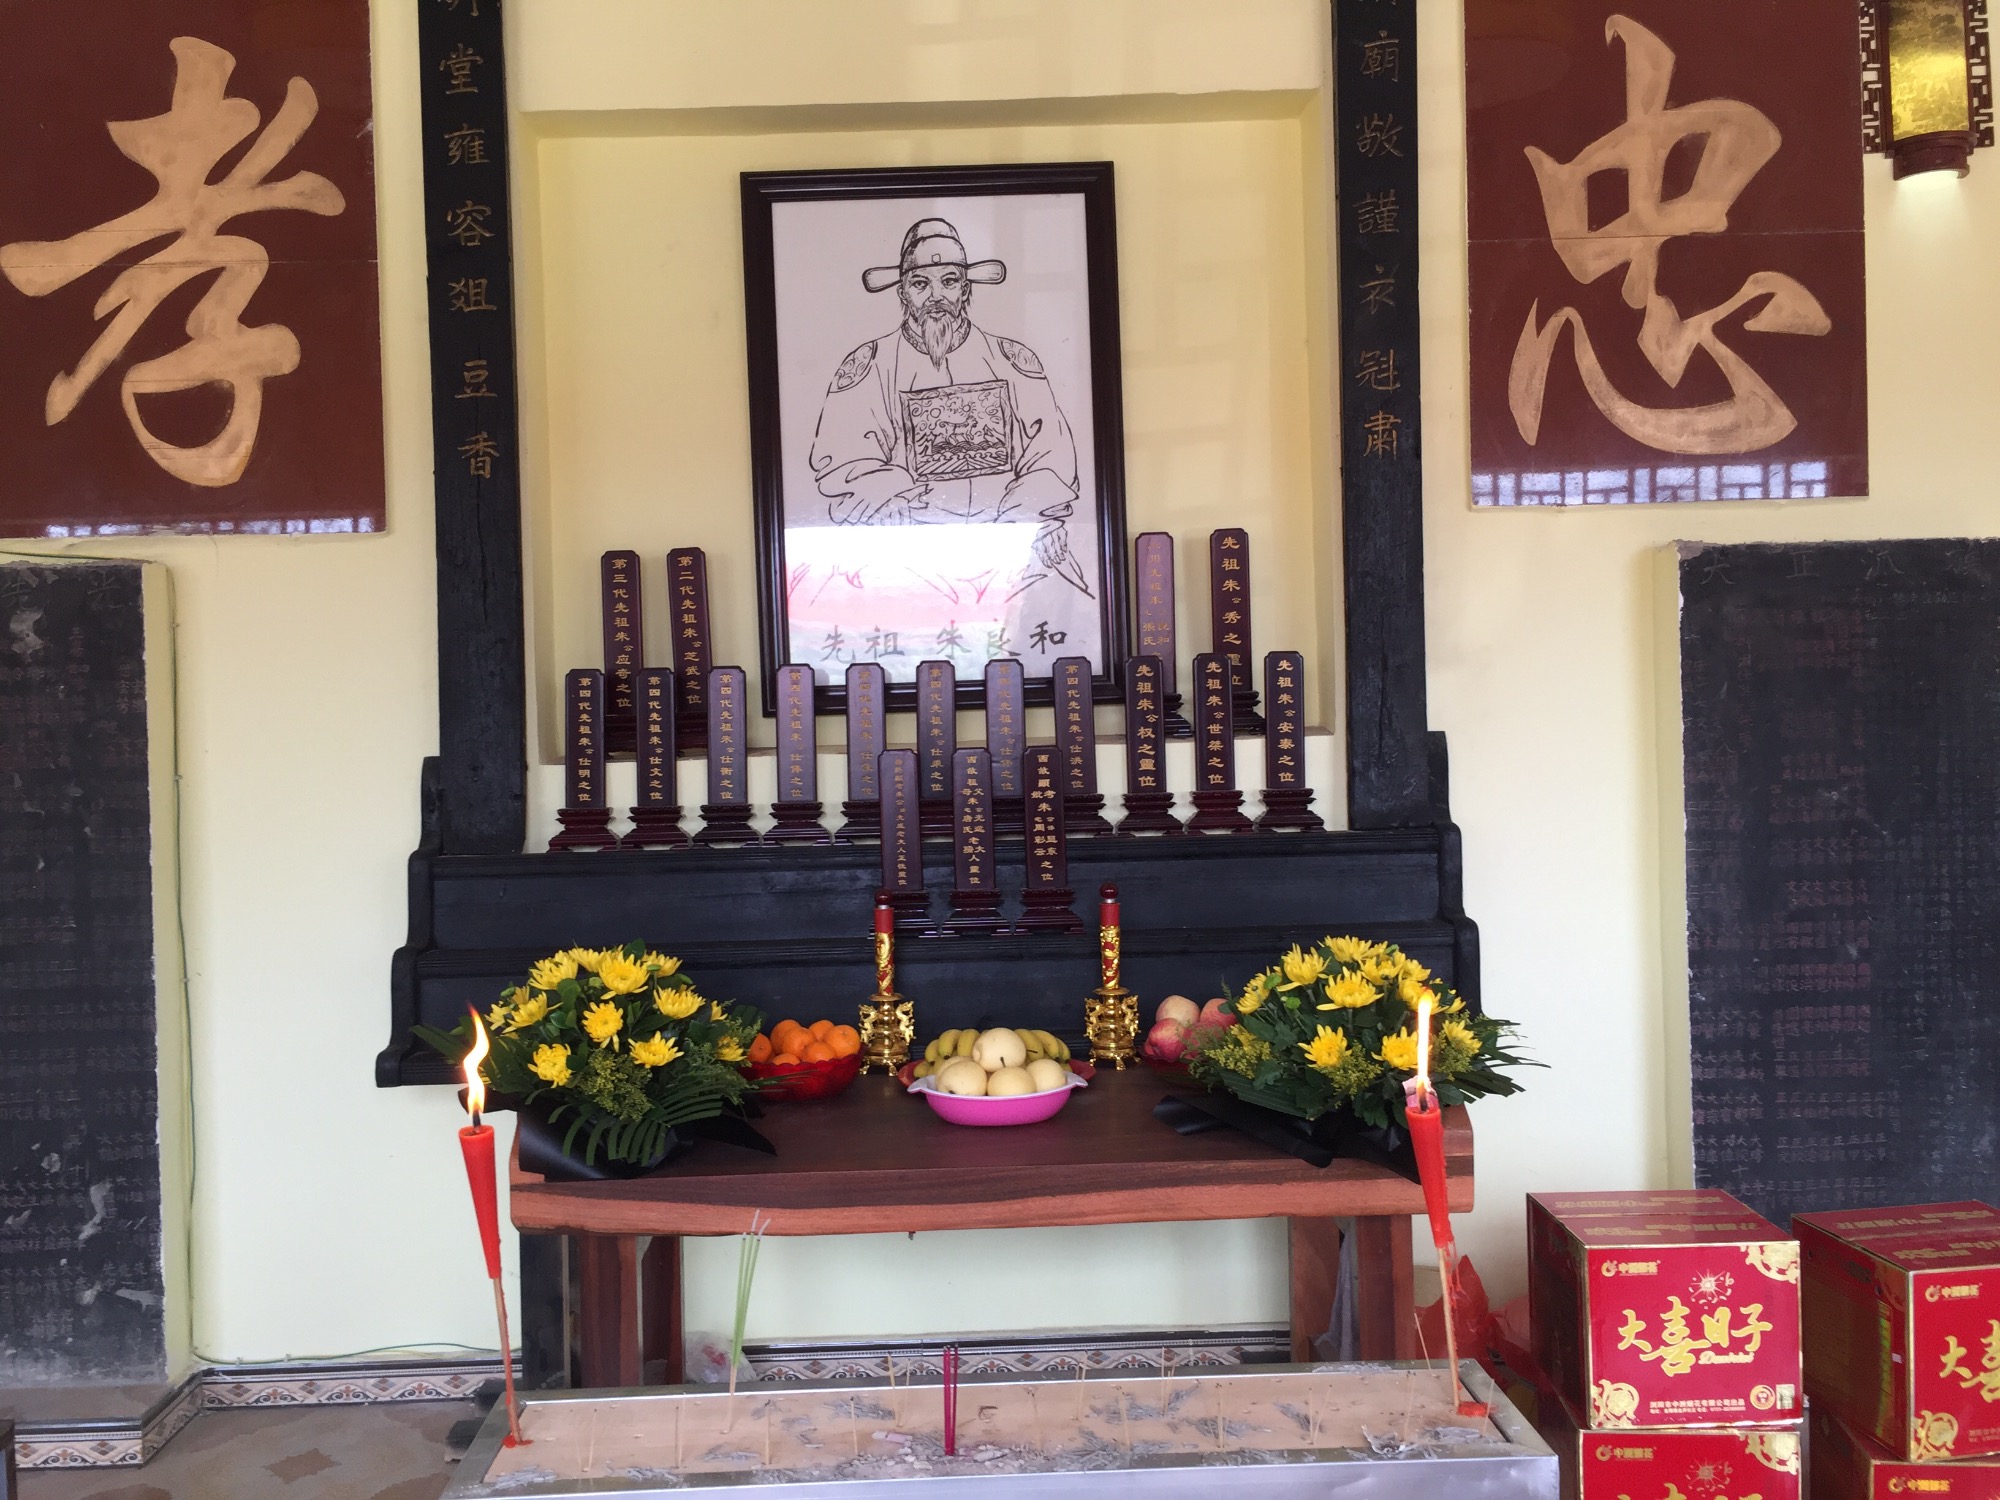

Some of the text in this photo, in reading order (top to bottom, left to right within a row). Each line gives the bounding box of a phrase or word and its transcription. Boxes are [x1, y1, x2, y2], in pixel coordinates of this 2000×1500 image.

[0, 36, 346, 488] 孝
[1508, 14, 1832, 455] 忠
[1618, 1295, 1773, 1378] 大喜日子
